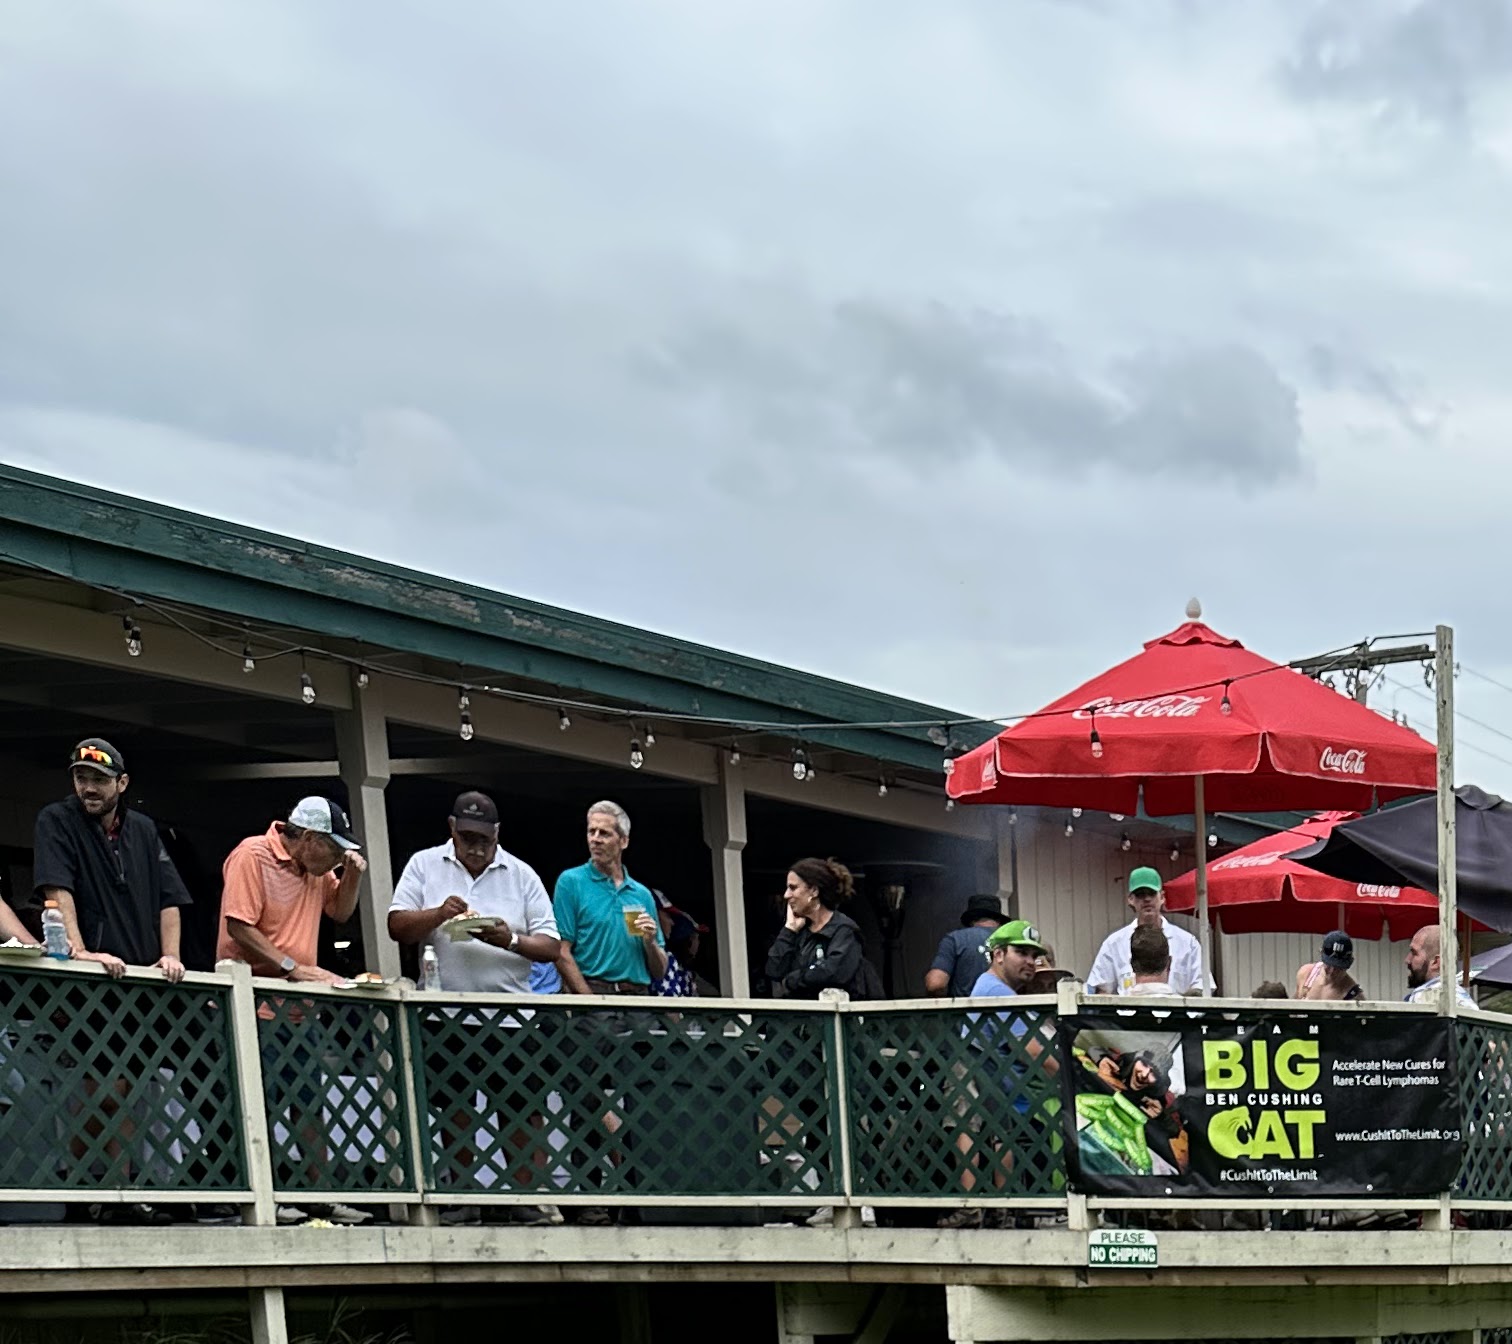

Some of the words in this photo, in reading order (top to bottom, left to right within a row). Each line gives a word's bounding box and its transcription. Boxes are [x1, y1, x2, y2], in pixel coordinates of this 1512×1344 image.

[1201, 1025, 1319, 1035] TEAM
[1202, 1039, 1321, 1091] BIG
[1332, 1060, 1381, 1071] Accelerate
[1382, 1060, 1404, 1070] New
[1404, 1059, 1431, 1070] Cures
[1432, 1058, 1446, 1070] for
[1333, 1075, 1354, 1086] Rare
[1355, 1075, 1381, 1086] T-Cell
[1382, 1074, 1440, 1088] Lymphomas
[1205, 1093, 1239, 1105] BEN
[1247, 1093, 1323, 1105] CUSHING
[1207, 1106, 1326, 1159] CAT
[1101, 1232, 1145, 1244] PLEASE
[1091, 1246, 1106, 1262] NO
[1108, 1246, 1156, 1263] CHIPPING
